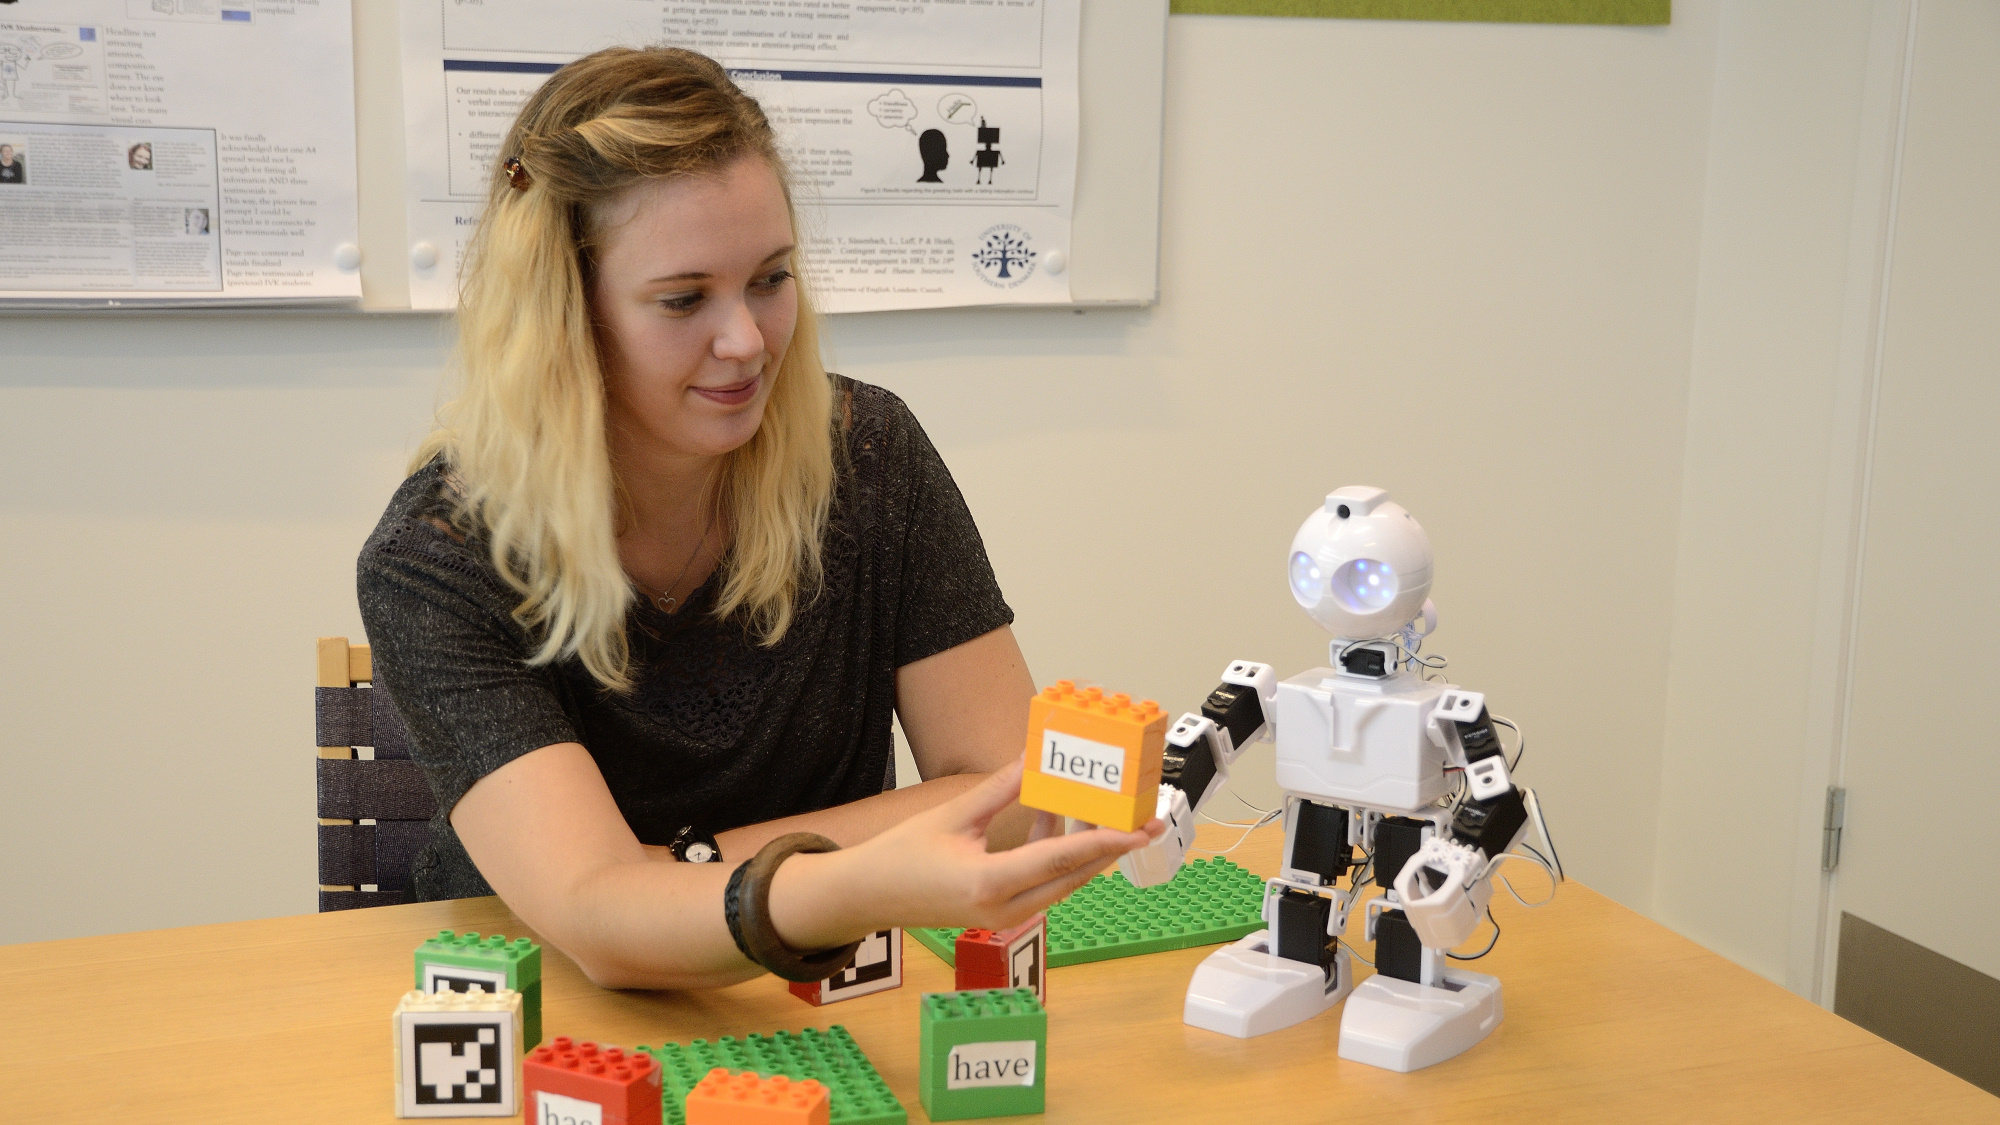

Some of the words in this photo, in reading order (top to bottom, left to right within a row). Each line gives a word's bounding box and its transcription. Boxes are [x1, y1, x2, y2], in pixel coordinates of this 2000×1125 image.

[671, 7, 696, 15] getting
[794, 11, 813, 20] rising
[106, 27, 140, 37] Headline
[732, 30, 775, 38] combination
[790, 31, 813, 39] lexical
[107, 40, 143, 48] attracting
[761, 42, 816, 50] attention-getting
[108, 62, 155, 70] composition
[135, 72, 149, 80] The
[730, 70, 782, 81] Conclusion
[143, 83, 164, 92] know
[456, 87, 471, 96] Our
[473, 87, 496, 96] results
[498, 88, 517, 96] show
[110, 93, 132, 101] where
[144, 94, 162, 103] look
[468, 98, 491, 107] verbal
[131, 104, 145, 112] Too
[787, 105, 821, 114] intonation
[112, 116, 133, 124] visual
[804, 118, 840, 126] impression
[842, 117, 852, 125] the
[221, 143, 272, 153] acknowledged
[274, 145, 288, 153] that
[247, 154, 269, 163] would
[286, 155, 294, 163] be
[810, 158, 829, 166] social
[222, 164, 250, 174] enough
[830, 168, 852, 176] should
[223, 176, 267, 184] information
[290, 177, 308, 185] three
[223, 186, 267, 194] testimonials
[224, 196, 240, 204] This
[259, 197, 271, 205] the
[272, 198, 297, 206] picture
[224, 208, 252, 216] attempt
[260, 207, 281, 215] could
[282, 207, 291, 215] be
[224, 217, 253, 226] recycled
[304, 218, 316, 226] the
[224, 227, 243, 235] three
[245, 228, 289, 236] testimonials
[978, 224, 1022, 241] UNIVERSITY
[225, 248, 241, 257] Page
[290, 249, 304, 257] and
[840, 247, 876, 256] Contingent
[225, 258, 249, 266] visuals
[828, 257, 859, 265] sustained
[227, 268, 242, 277] Page
[261, 269, 304, 277] testimonials
[849, 266, 869, 274] Robot
[970, 260, 1005, 289] SOUTHERN
[1008, 262, 1037, 289] DENMARK
[1049, 740, 1119, 785] here
[954, 1053, 1029, 1081] have
